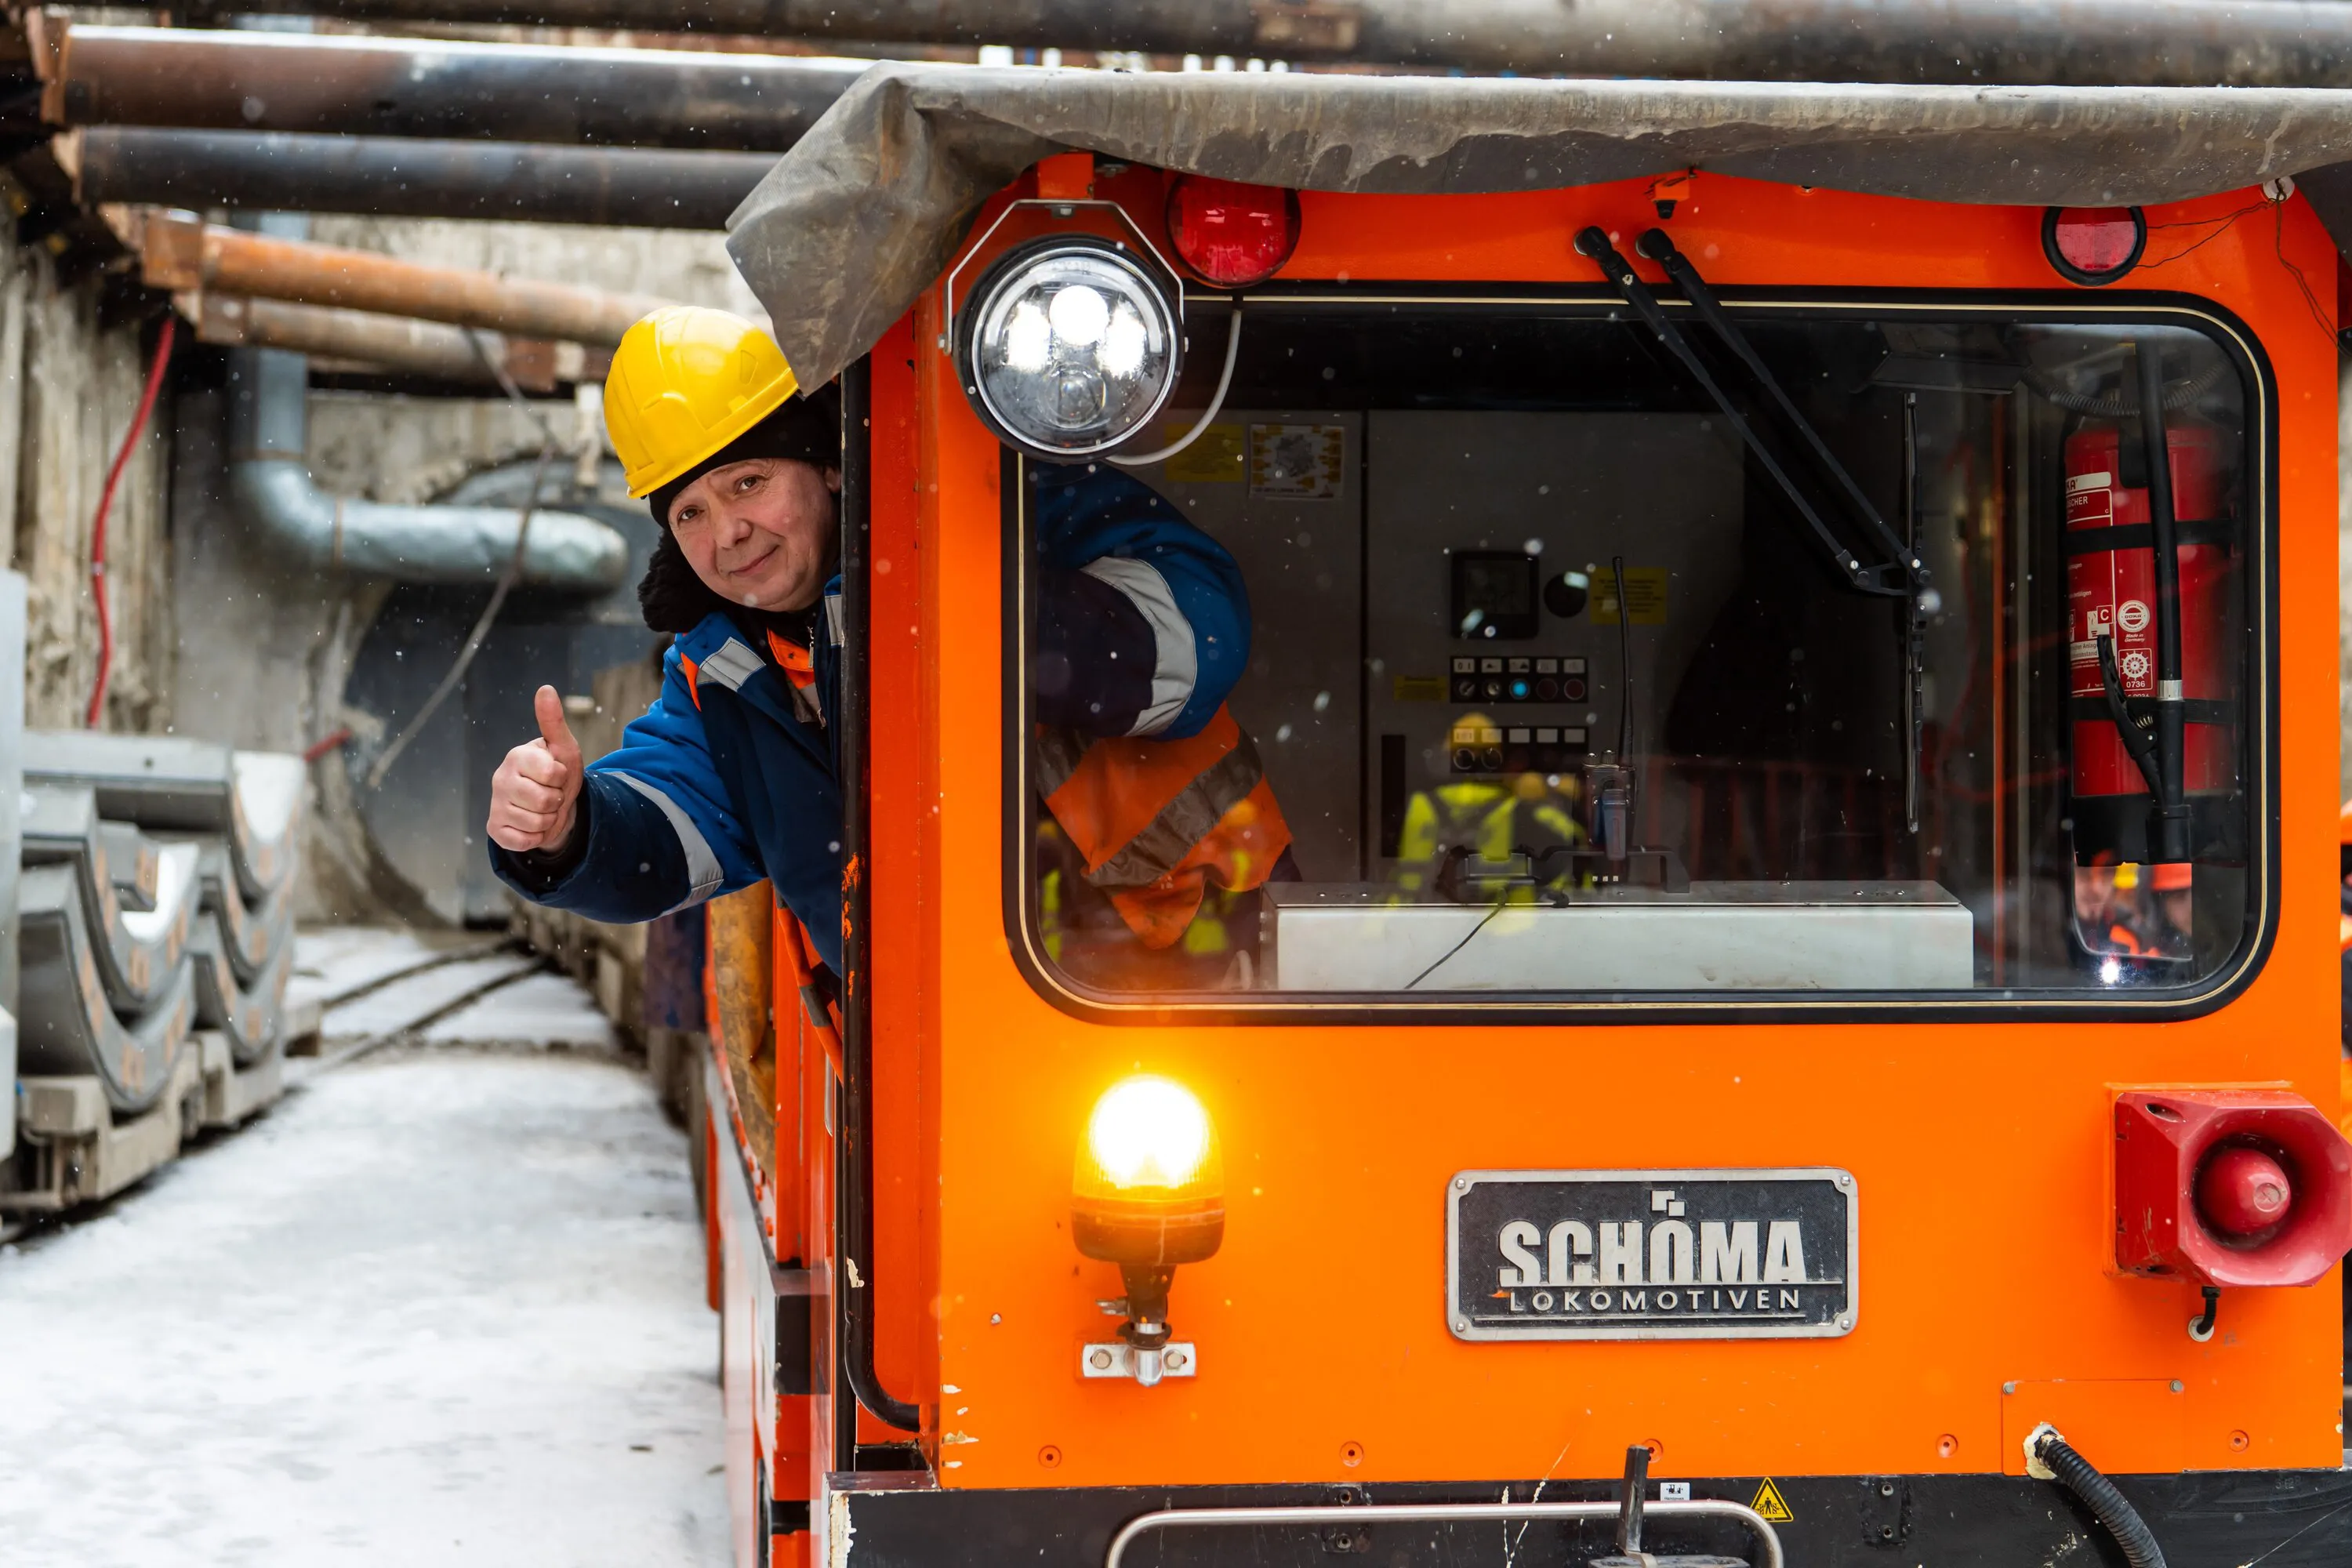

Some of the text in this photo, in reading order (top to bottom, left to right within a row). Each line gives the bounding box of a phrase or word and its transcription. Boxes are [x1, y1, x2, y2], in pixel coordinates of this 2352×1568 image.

[2100, 609, 2109, 621] C
[1498, 1189, 1806, 1287] SCHÖMA
[1509, 1289, 1801, 1312] LOKOMOTIVEN
